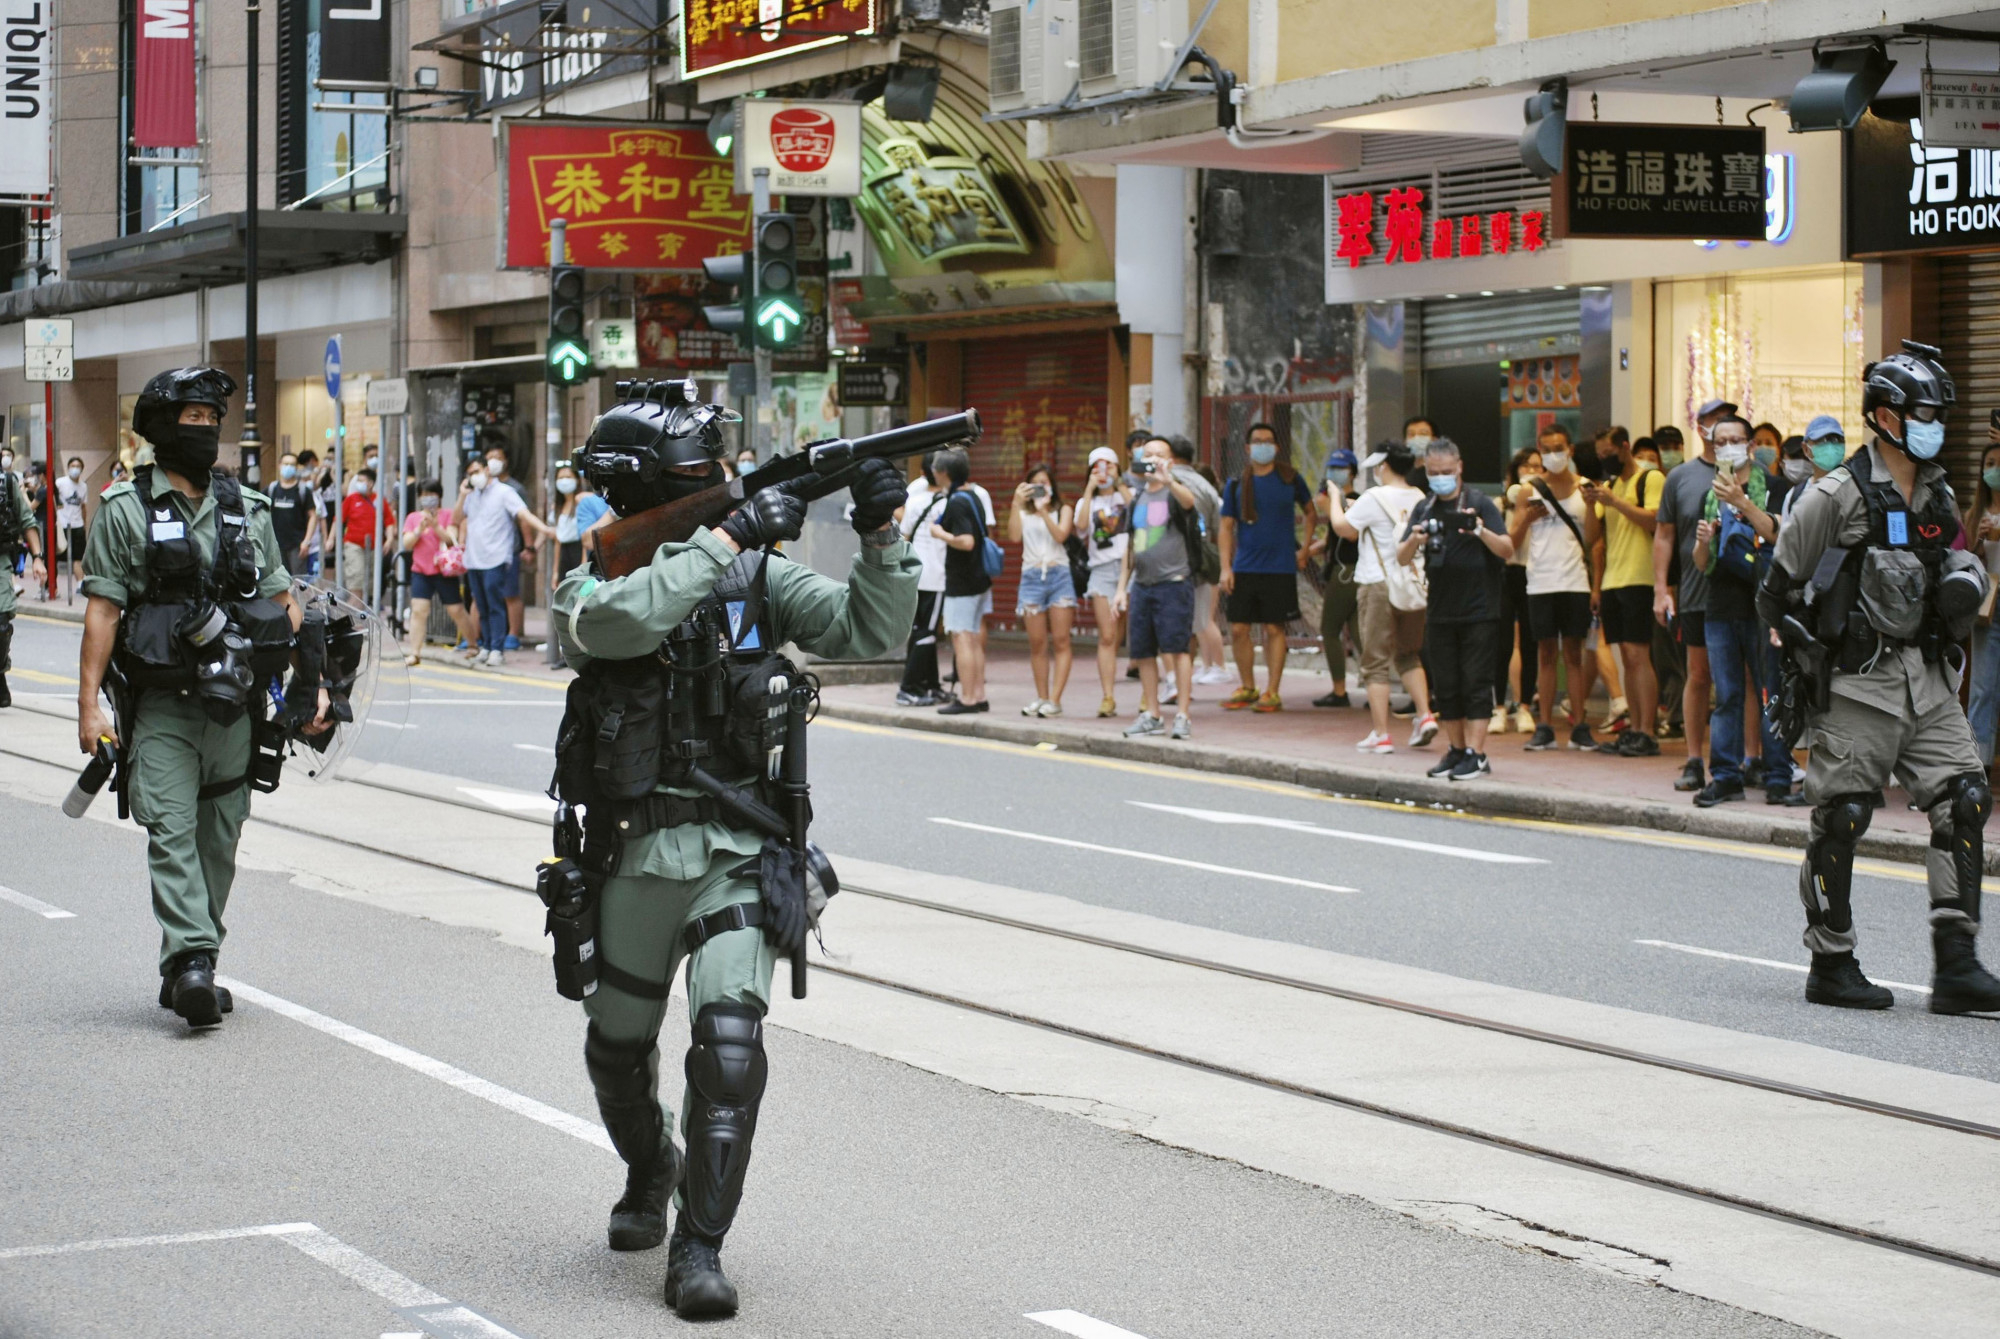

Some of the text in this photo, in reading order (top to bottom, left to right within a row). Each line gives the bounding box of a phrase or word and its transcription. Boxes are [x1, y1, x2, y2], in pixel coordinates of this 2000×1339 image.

[1971, 82, 1987, 94] Bay
[617, 138, 675, 157] 老字號
[1577, 150, 1760, 198] 浩福珠寶
[545, 161, 745, 219] 恭和堂
[1577, 197, 1760, 213] HO FOOK JEWELLERY
[1909, 209, 1940, 236] HO
[56, 366, 70, 378] 12
